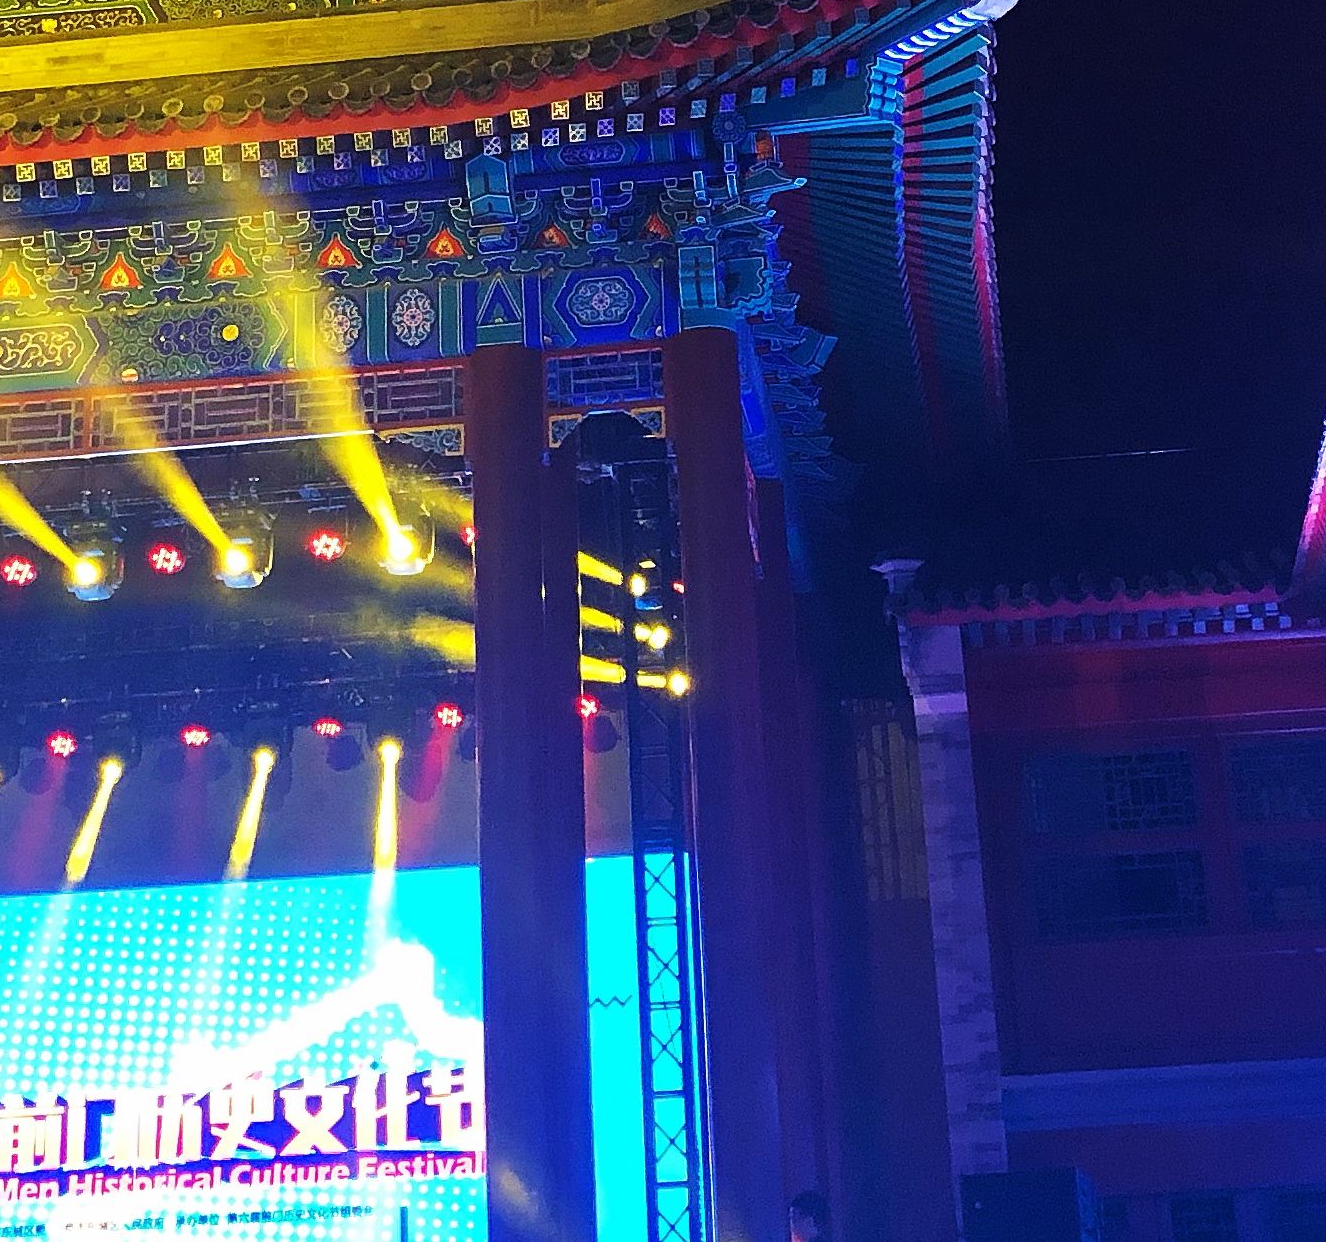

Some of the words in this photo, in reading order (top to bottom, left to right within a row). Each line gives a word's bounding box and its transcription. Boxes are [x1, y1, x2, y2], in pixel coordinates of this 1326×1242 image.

[67, 1162, 223, 1198] Historical
[229, 1160, 351, 1190] Culture
[357, 1152, 484, 1182] Festival
